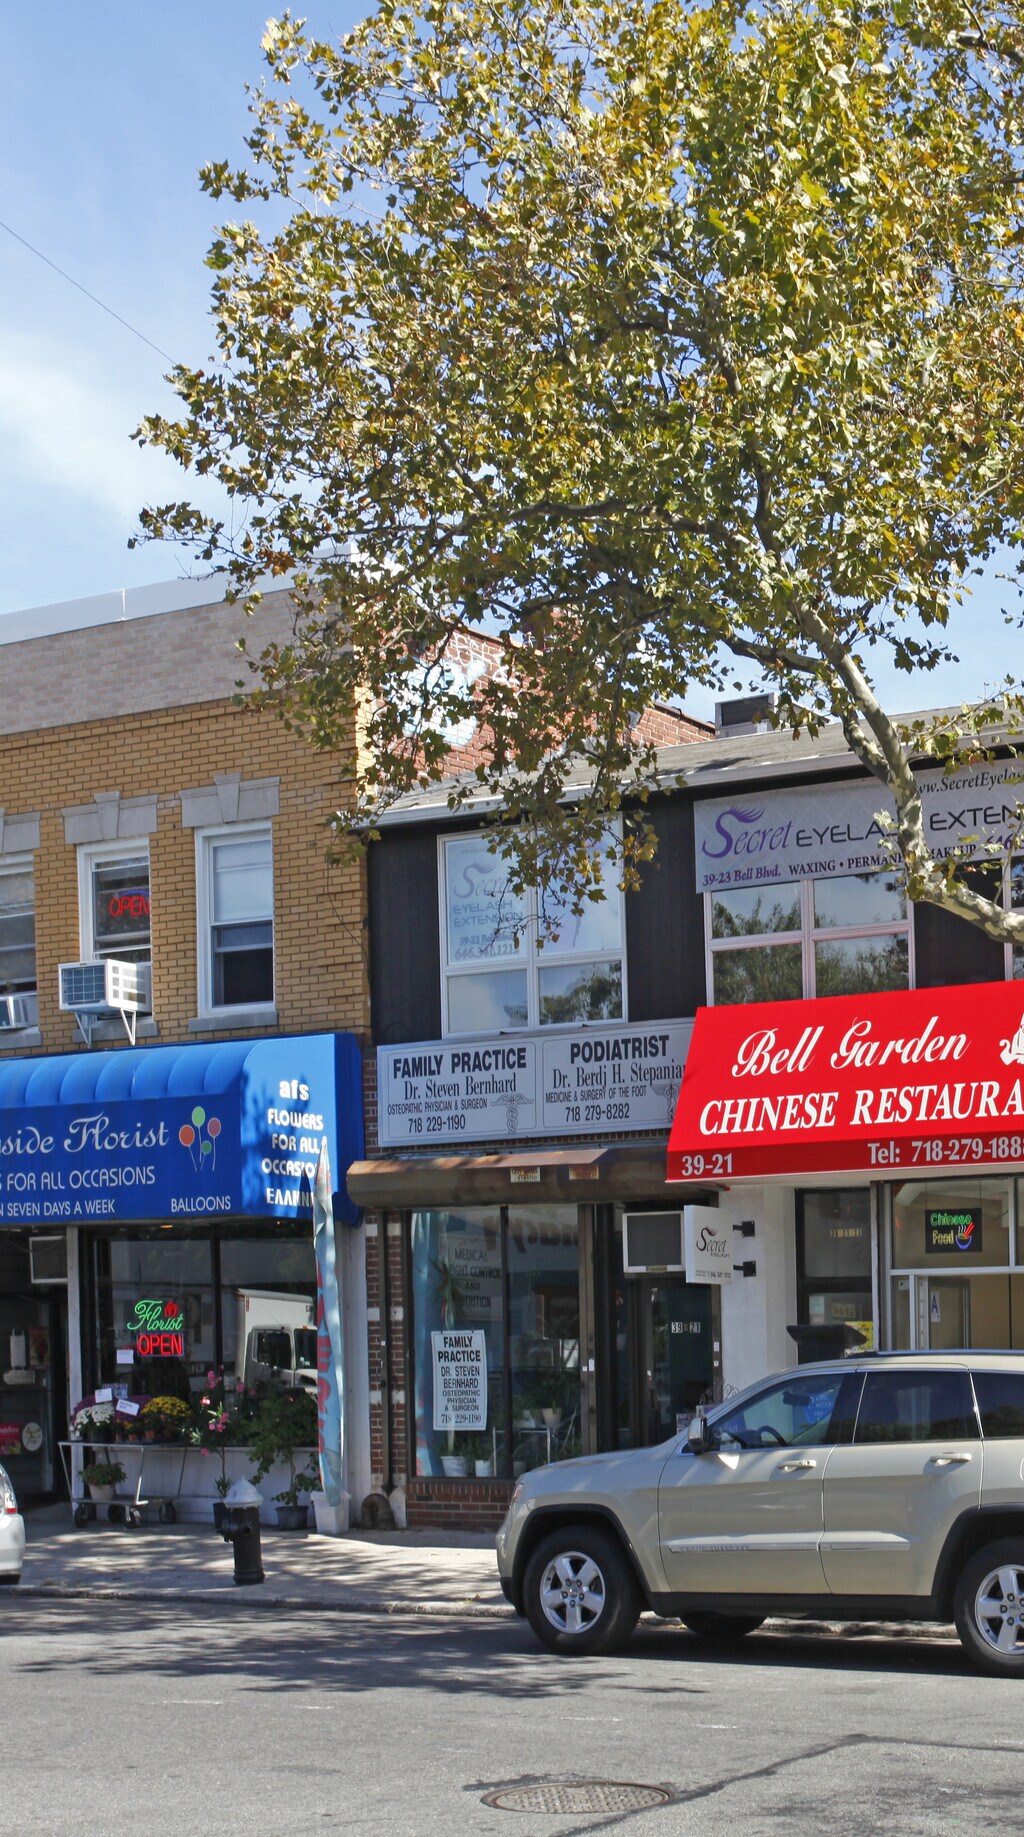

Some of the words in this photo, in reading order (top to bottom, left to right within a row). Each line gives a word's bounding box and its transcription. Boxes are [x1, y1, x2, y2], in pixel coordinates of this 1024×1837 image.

[701, 806, 794, 859] Secret
[796, 818, 899, 848] EYELA
[702, 871, 731, 887] 39-23
[734, 870, 753, 882] Bell
[756, 864, 781, 880] Blvd.
[789, 860, 836, 876] WAXING
[847, 852, 904, 869] PERMANE
[453, 862, 514, 899] Secre
[109, 895, 150, 917] OPEN
[453, 900, 513, 914] EYELASH
[454, 911, 523, 927] EXTENSION
[570, 1035, 669, 1064] PODIATRIST
[731, 1025, 824, 1077] Bell
[831, 1016, 971, 1069] Garden
[393, 1055, 443, 1079] FAMILY
[451, 1048, 526, 1074] PRACTICE
[404, 1080, 420, 1100] Dr.
[425, 1078, 460, 1098] Steven
[465, 1072, 516, 1095] Bernhard
[553, 1069, 570, 1089] Dr.
[576, 1065, 607, 1089] Berdj
[612, 1064, 625, 1084] H.
[545, 1091, 571, 1103] MEDICINE
[574, 1090, 578, 1101] &
[581, 1088, 606, 1101] SURGERY
[609, 1088, 616, 1099] OF
[619, 1086, 629, 1098] THE
[632, 1085, 647, 1097] FOOT
[388, 1102, 422, 1115] OSTEOPATHIC
[425, 1100, 452, 1113] PHYSICIAN
[454, 1100, 458, 1110] &
[461, 1098, 488, 1110] SURGEON
[565, 1106, 580, 1122] 718
[585, 1102, 630, 1121] 279-8282
[700, 1091, 839, 1136] CHINESE
[267, 1108, 324, 1131] FLOWERS
[408, 1118, 422, 1133] 718
[427, 1114, 466, 1132] 229-1190
[0, 1126, 55, 1155] side
[64, 1111, 169, 1152] Florist
[271, 1133, 297, 1151] FOR
[300, 1137, 320, 1155] ALL
[261, 1158, 317, 1179] OCCASIO
[681, 1153, 733, 1176] 39-21
[868, 1142, 900, 1165] Tel:
[7, 1172, 36, 1191] FOR
[41, 1171, 65, 1190] ALL
[69, 1166, 155, 1189] OCCASIONS
[7, 1202, 40, 1217] SEVEN
[44, 1200, 71, 1216] DAYS
[74, 1201, 82, 1214] A
[85, 1199, 116, 1214] WEEK
[171, 1196, 231, 1213] BALLOONS
[930, 1213, 972, 1227] Chinese
[696, 1226, 727, 1252] Secret
[932, 1230, 954, 1245] Food
[454, 1247, 488, 1262] MEDICAL
[450, 1265, 468, 1278] EIGHT
[464, 1281, 480, 1291] AND
[459, 1296, 491, 1308] TRITION
[931, 1295, 939, 1314] A
[127, 1299, 183, 1331] Florist
[138, 1334, 182, 1355] OPEN
[443, 1336, 473, 1348] FAMILY
[438, 1350, 481, 1363] PRACTICE
[441, 1366, 452, 1377] DR.
[455, 1366, 480, 1377] STEVEN
[443, 1378, 478, 1389] BERNHARD
[455, 1413, 481, 1424] 229-1190
